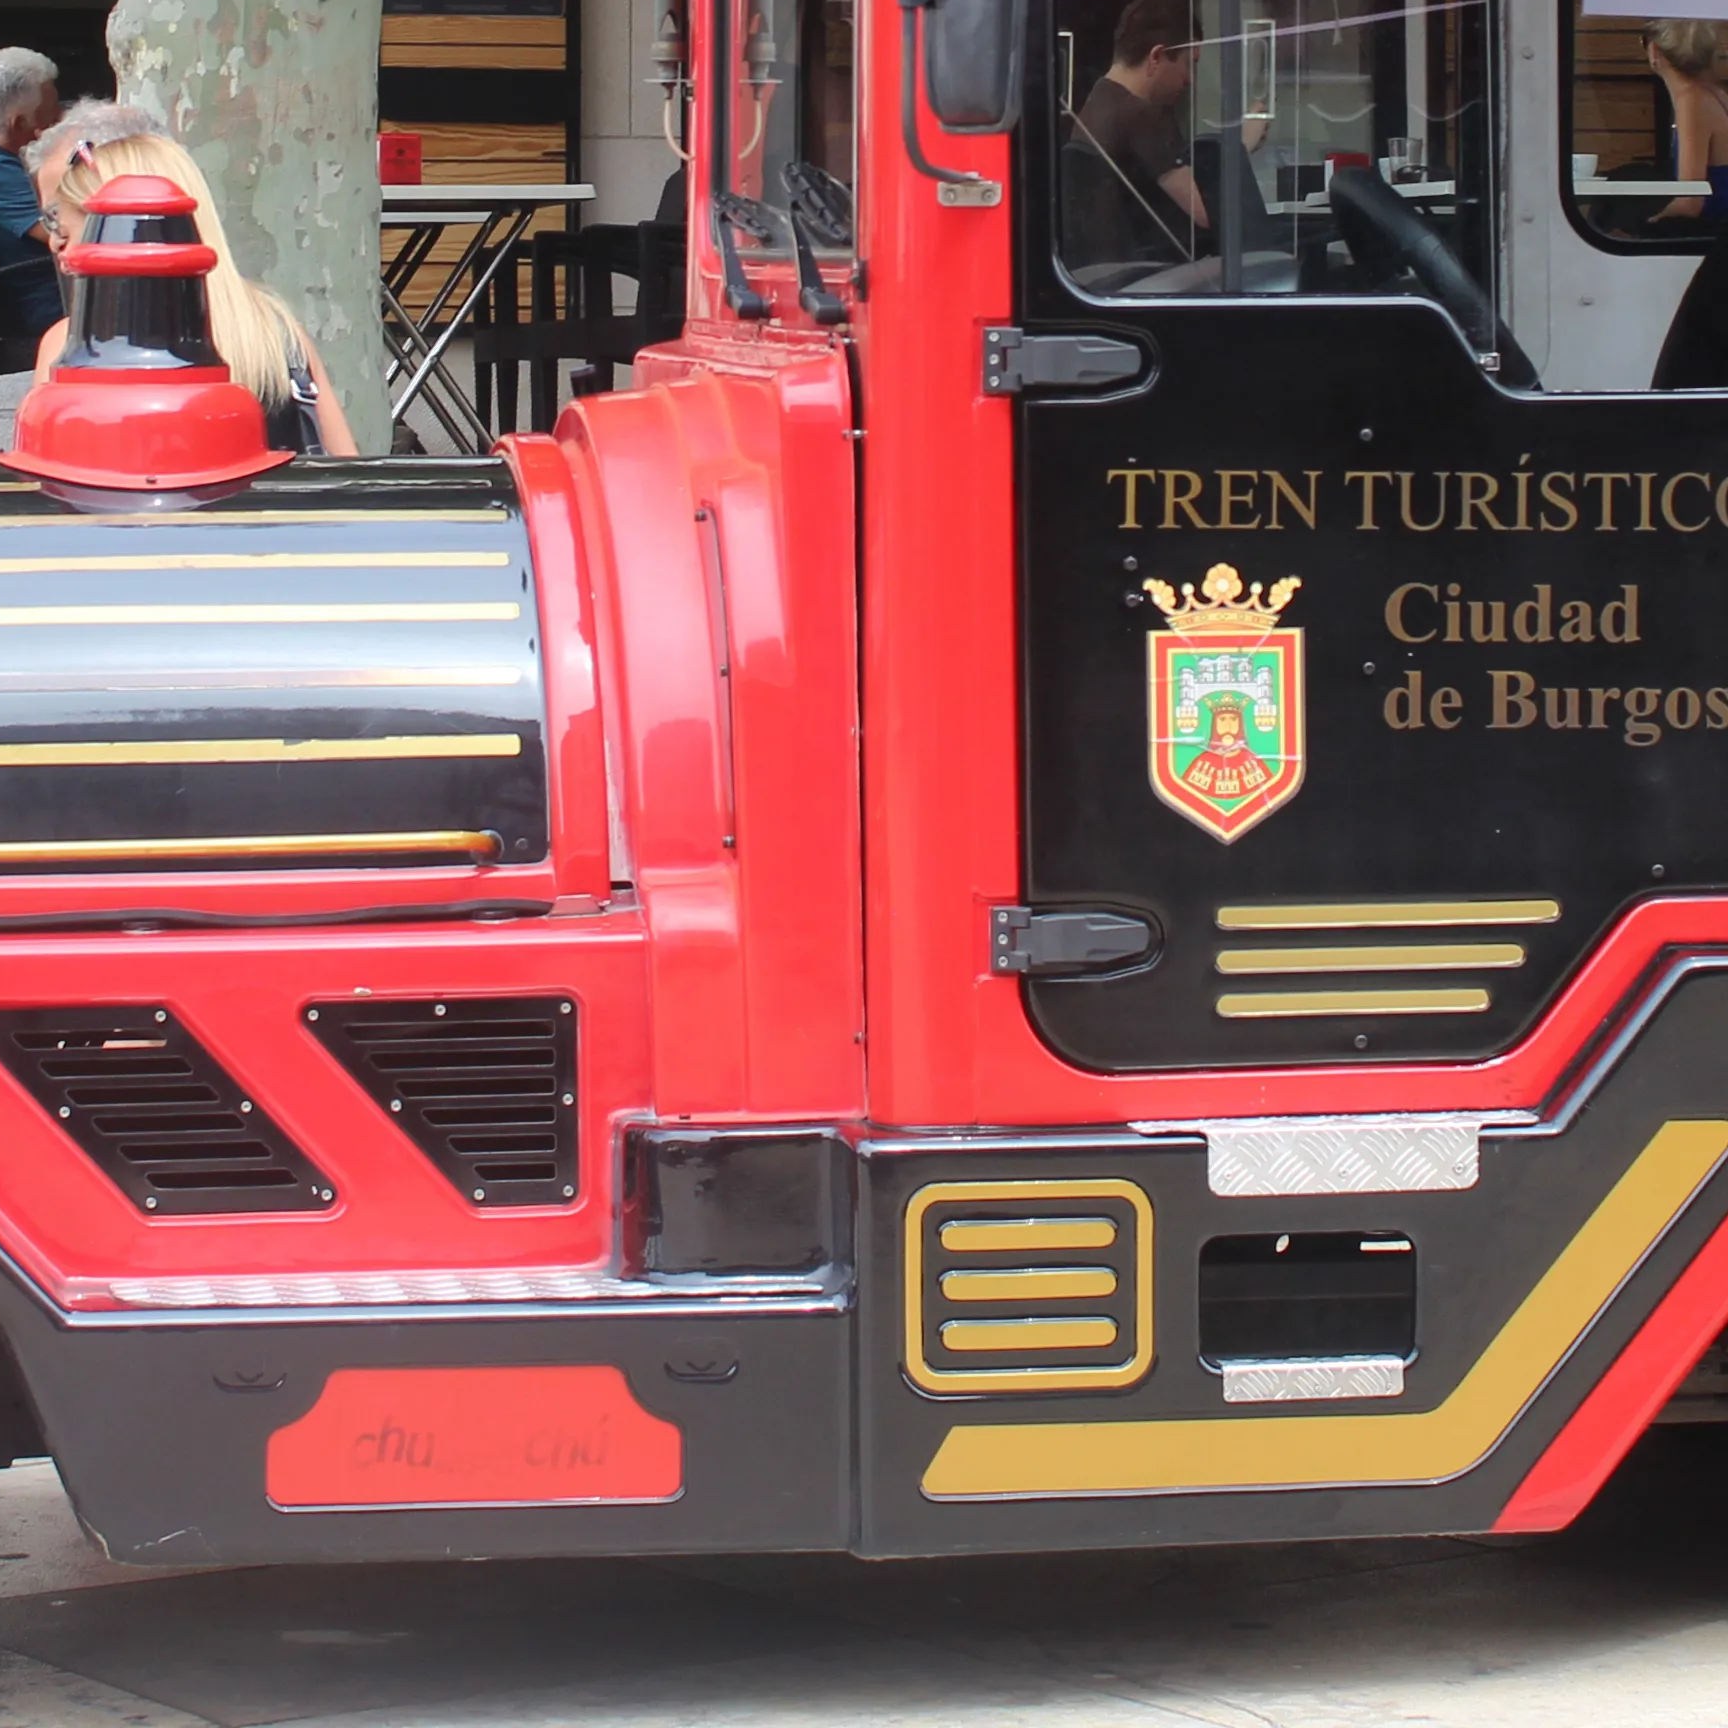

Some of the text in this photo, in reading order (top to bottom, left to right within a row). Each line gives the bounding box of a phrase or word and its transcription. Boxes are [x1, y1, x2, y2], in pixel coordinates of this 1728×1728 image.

[1106, 468, 1323, 530] TREN
[1384, 582, 1642, 644] Ciudad
[1382, 670, 1464, 731] de
